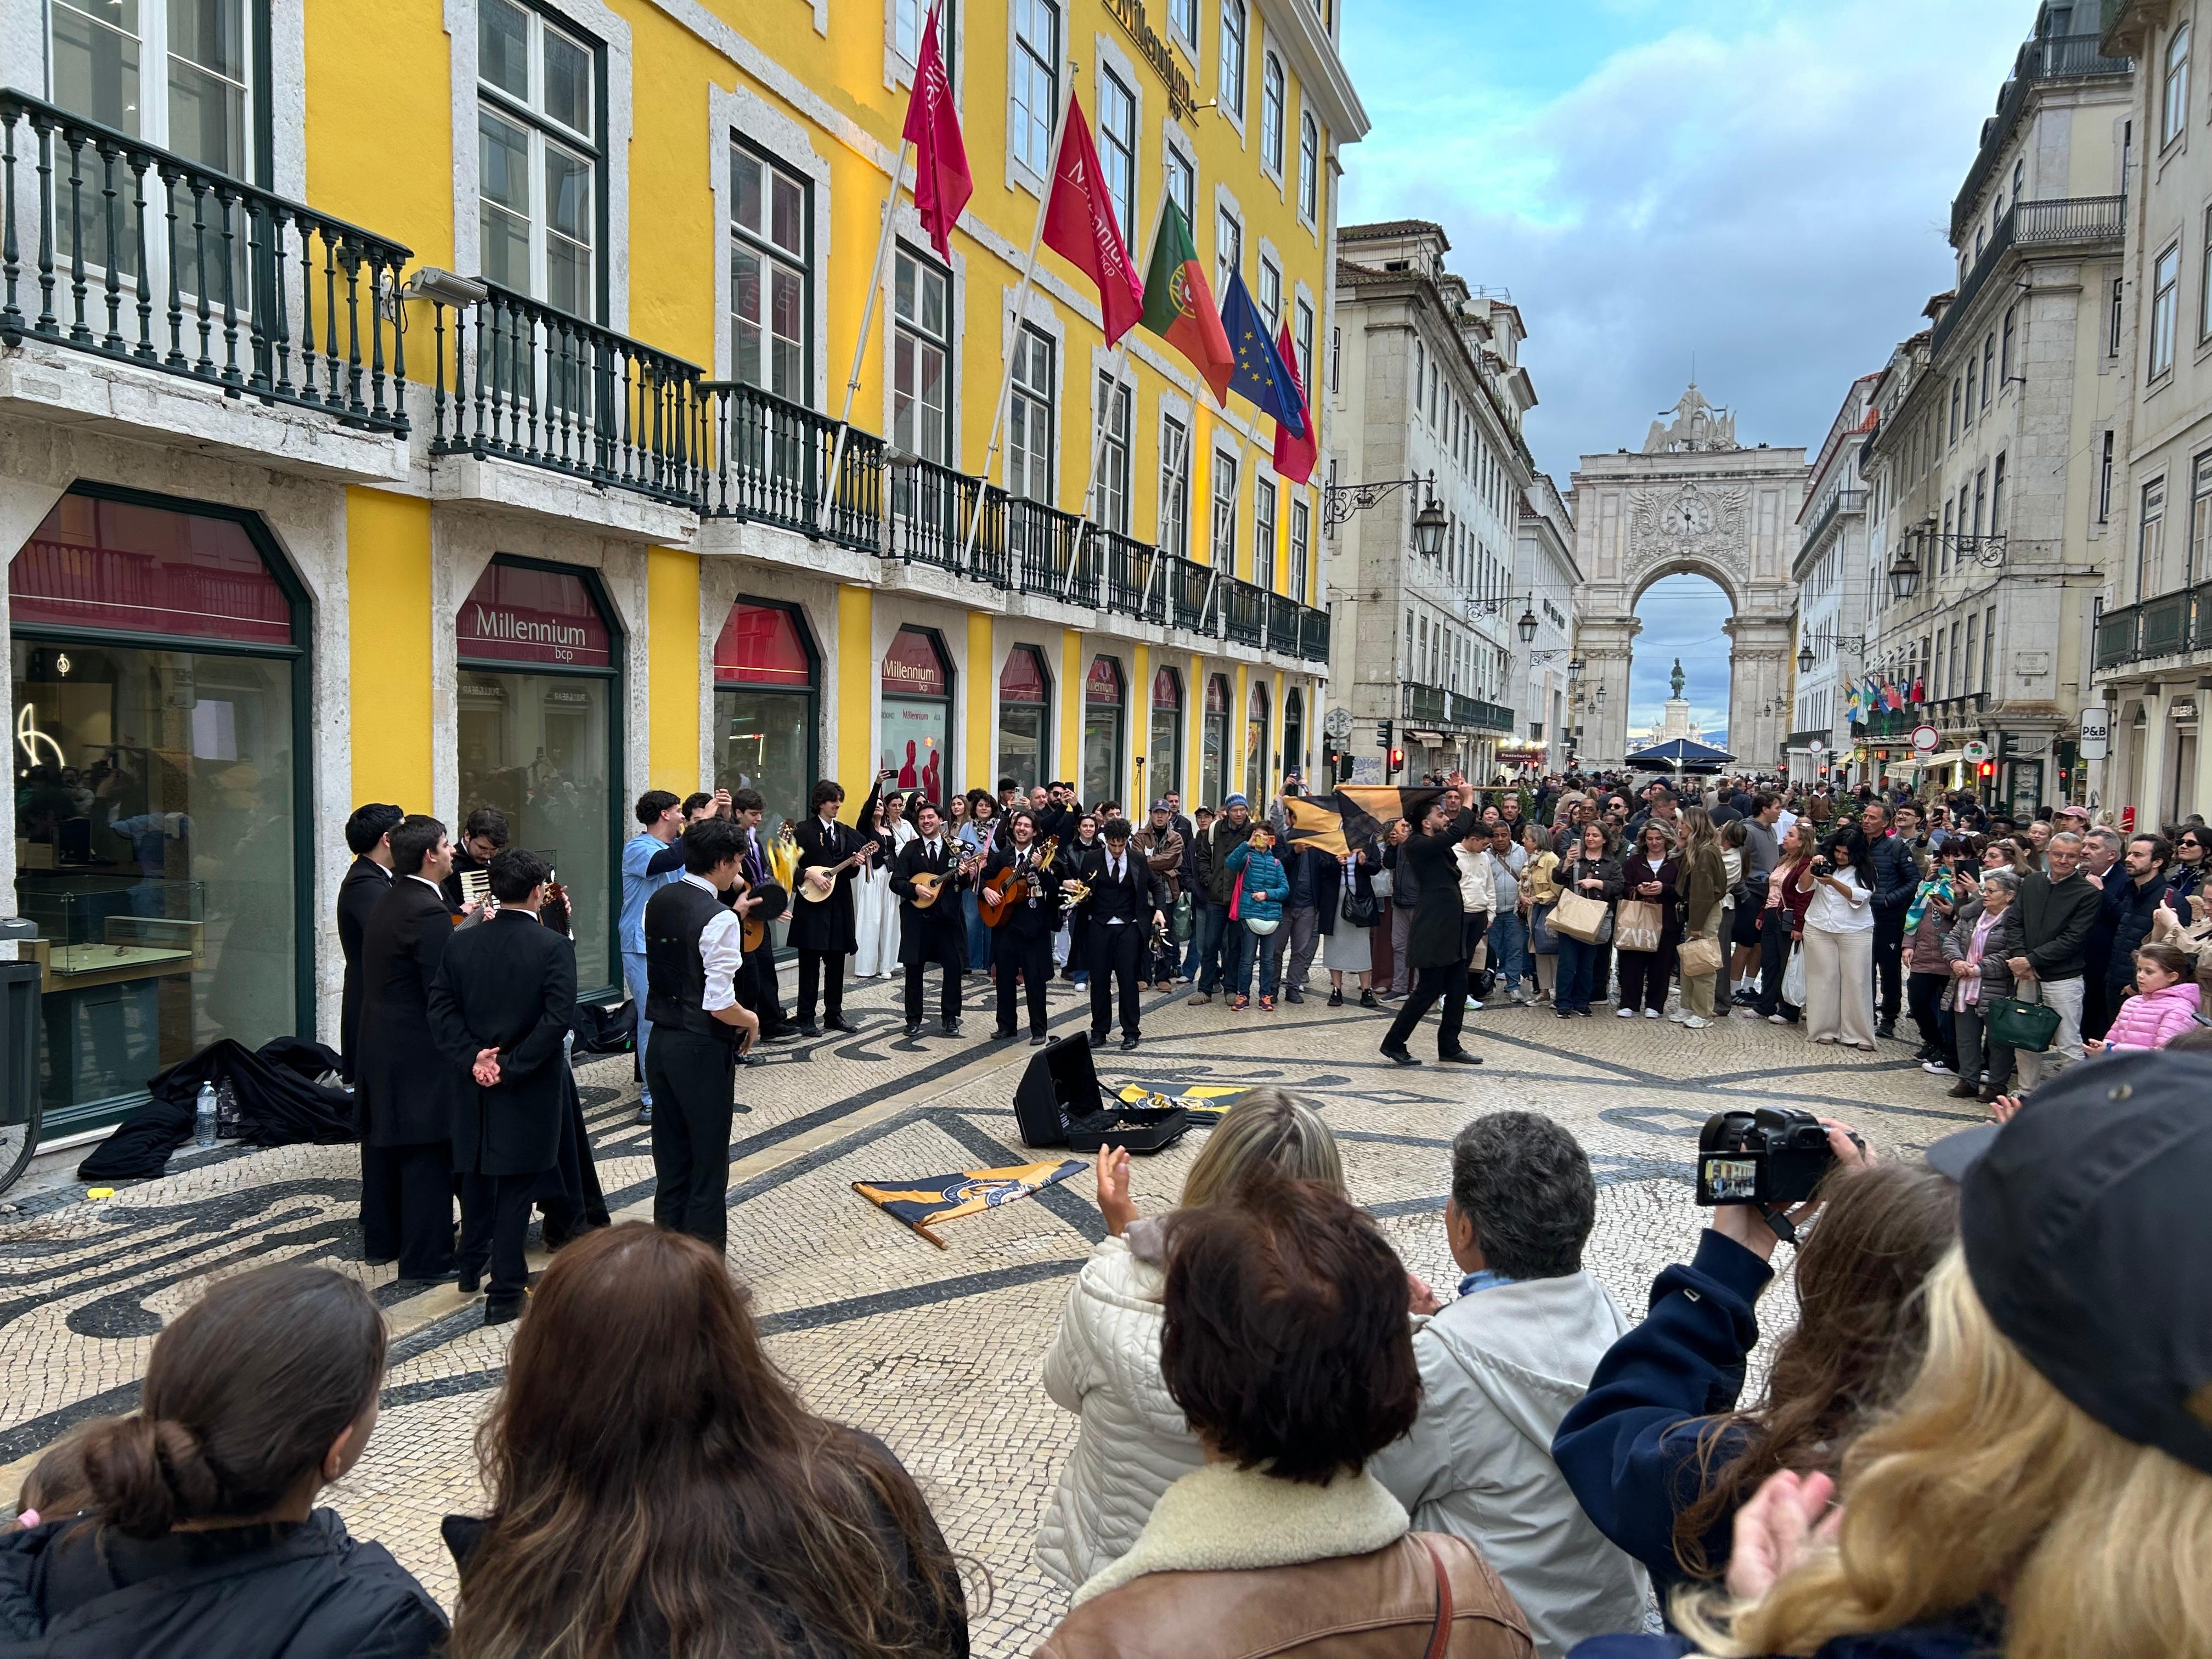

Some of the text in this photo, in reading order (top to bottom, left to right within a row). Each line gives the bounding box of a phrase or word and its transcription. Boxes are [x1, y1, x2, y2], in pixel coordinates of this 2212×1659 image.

[475, 603, 585, 646] Millennium
[555, 646, 573, 663] bcp
[883, 657, 934, 681] Millennium
[919, 682, 928, 692] bcp
[902, 708, 929, 720] Millennium
[2083, 726, 2106, 736] P&B
